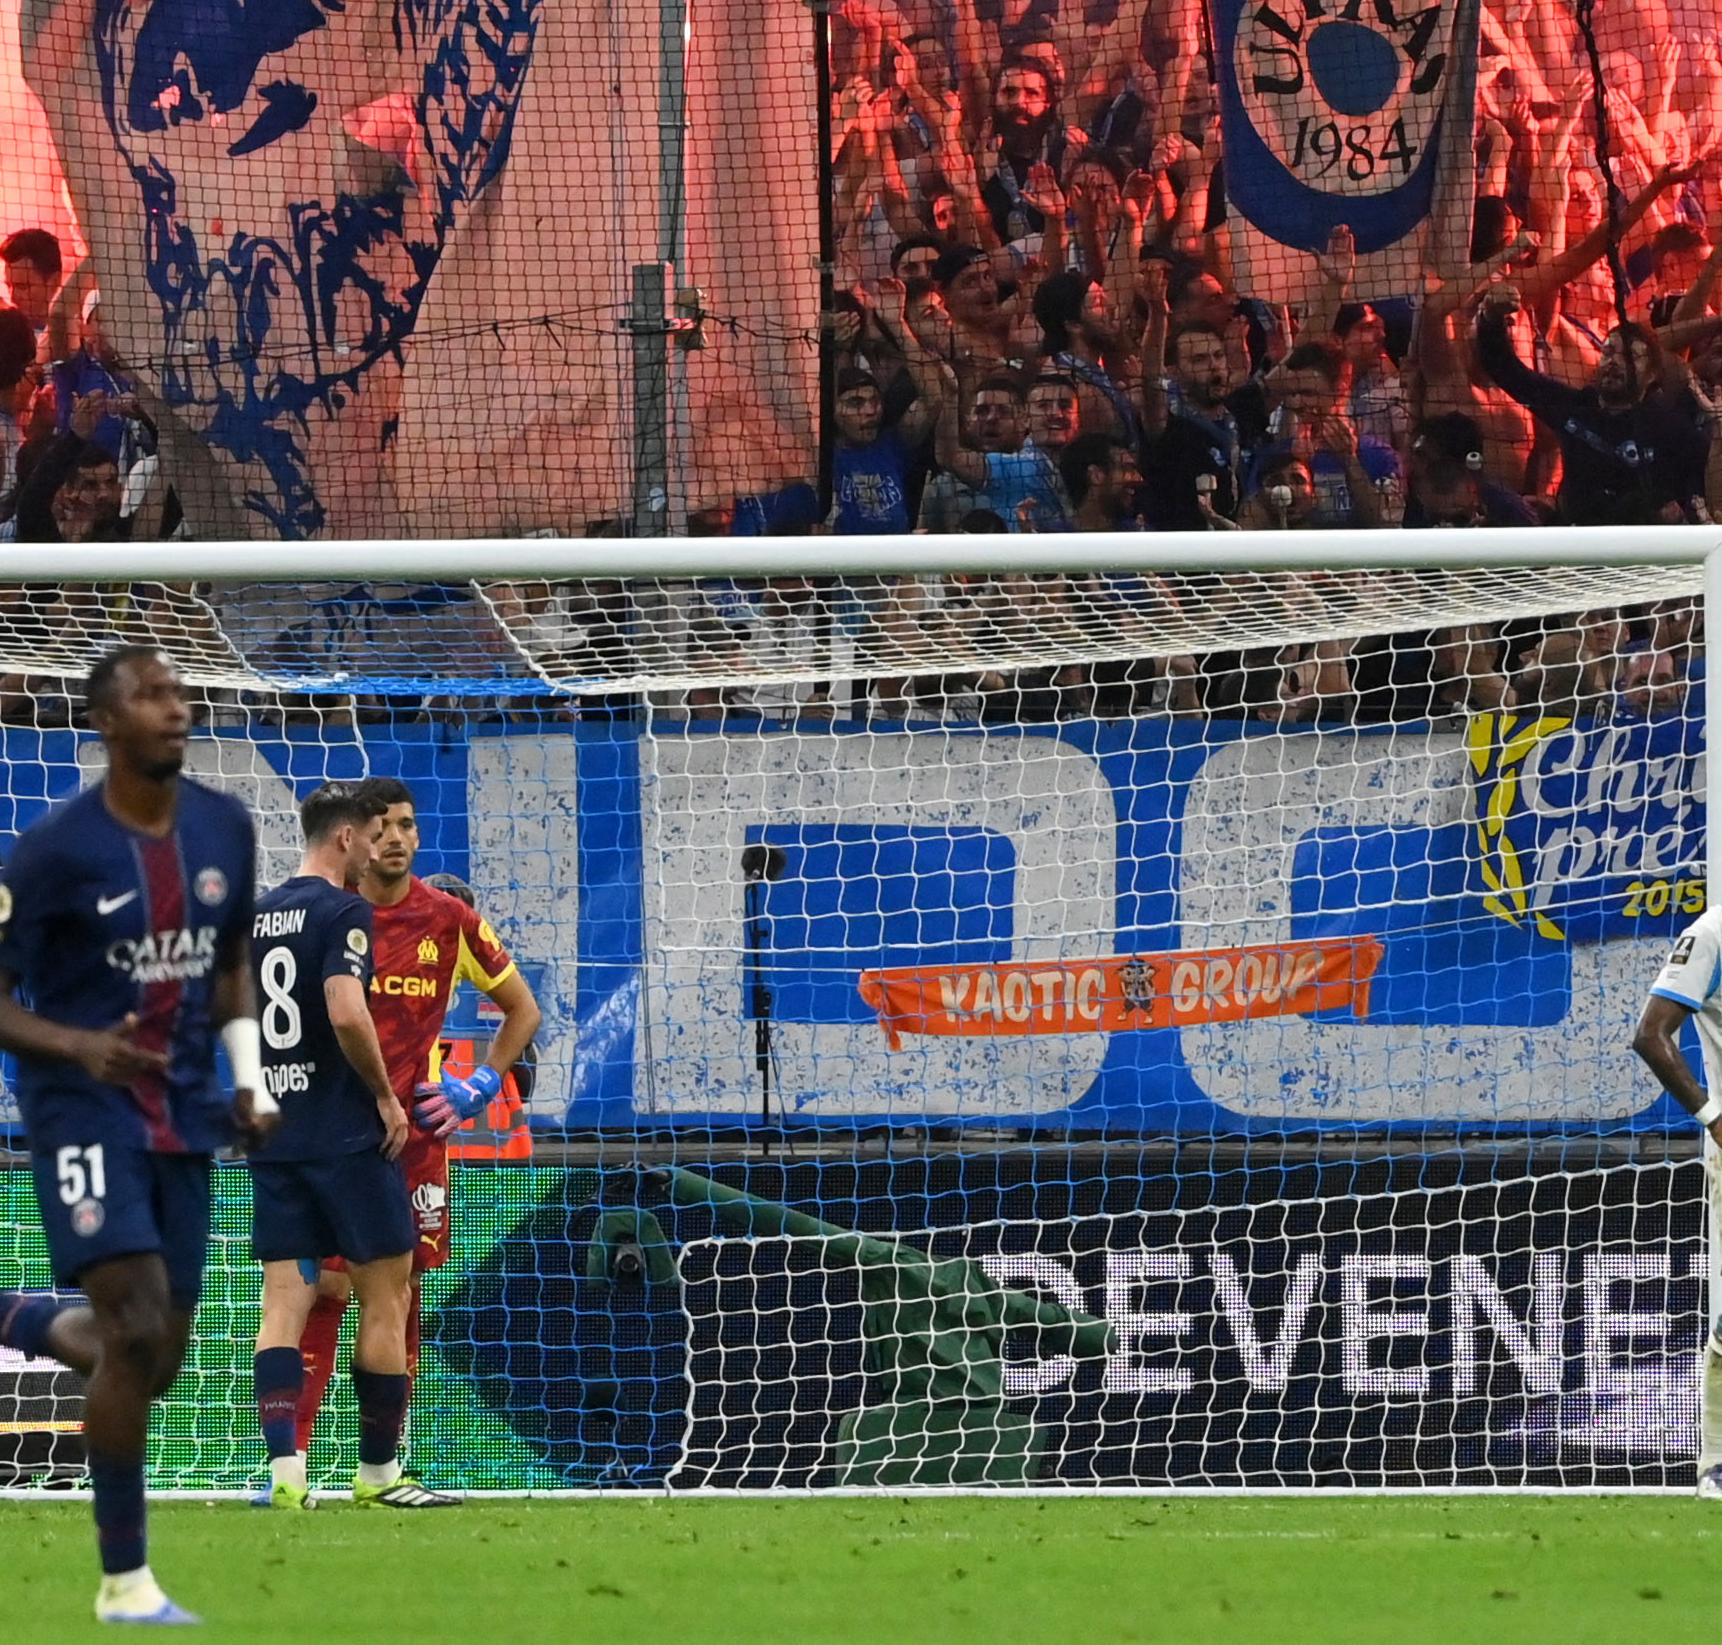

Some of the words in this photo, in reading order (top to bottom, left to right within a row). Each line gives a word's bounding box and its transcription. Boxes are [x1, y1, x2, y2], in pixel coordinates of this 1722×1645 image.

[1291, 115, 1418, 182] 1984
[252, 908, 307, 939] FABIAN
[1622, 879, 1707, 917] 2015
[106, 925, 218, 970] QATAR
[260, 945, 303, 1051] 8
[383, 975, 438, 998] CGM
[938, 966, 1108, 1024] KAOTIC
[1173, 948, 1327, 1014] GROUP
[56, 1141, 106, 1206] 51
[981, 1253, 1709, 1395] DEVENE
